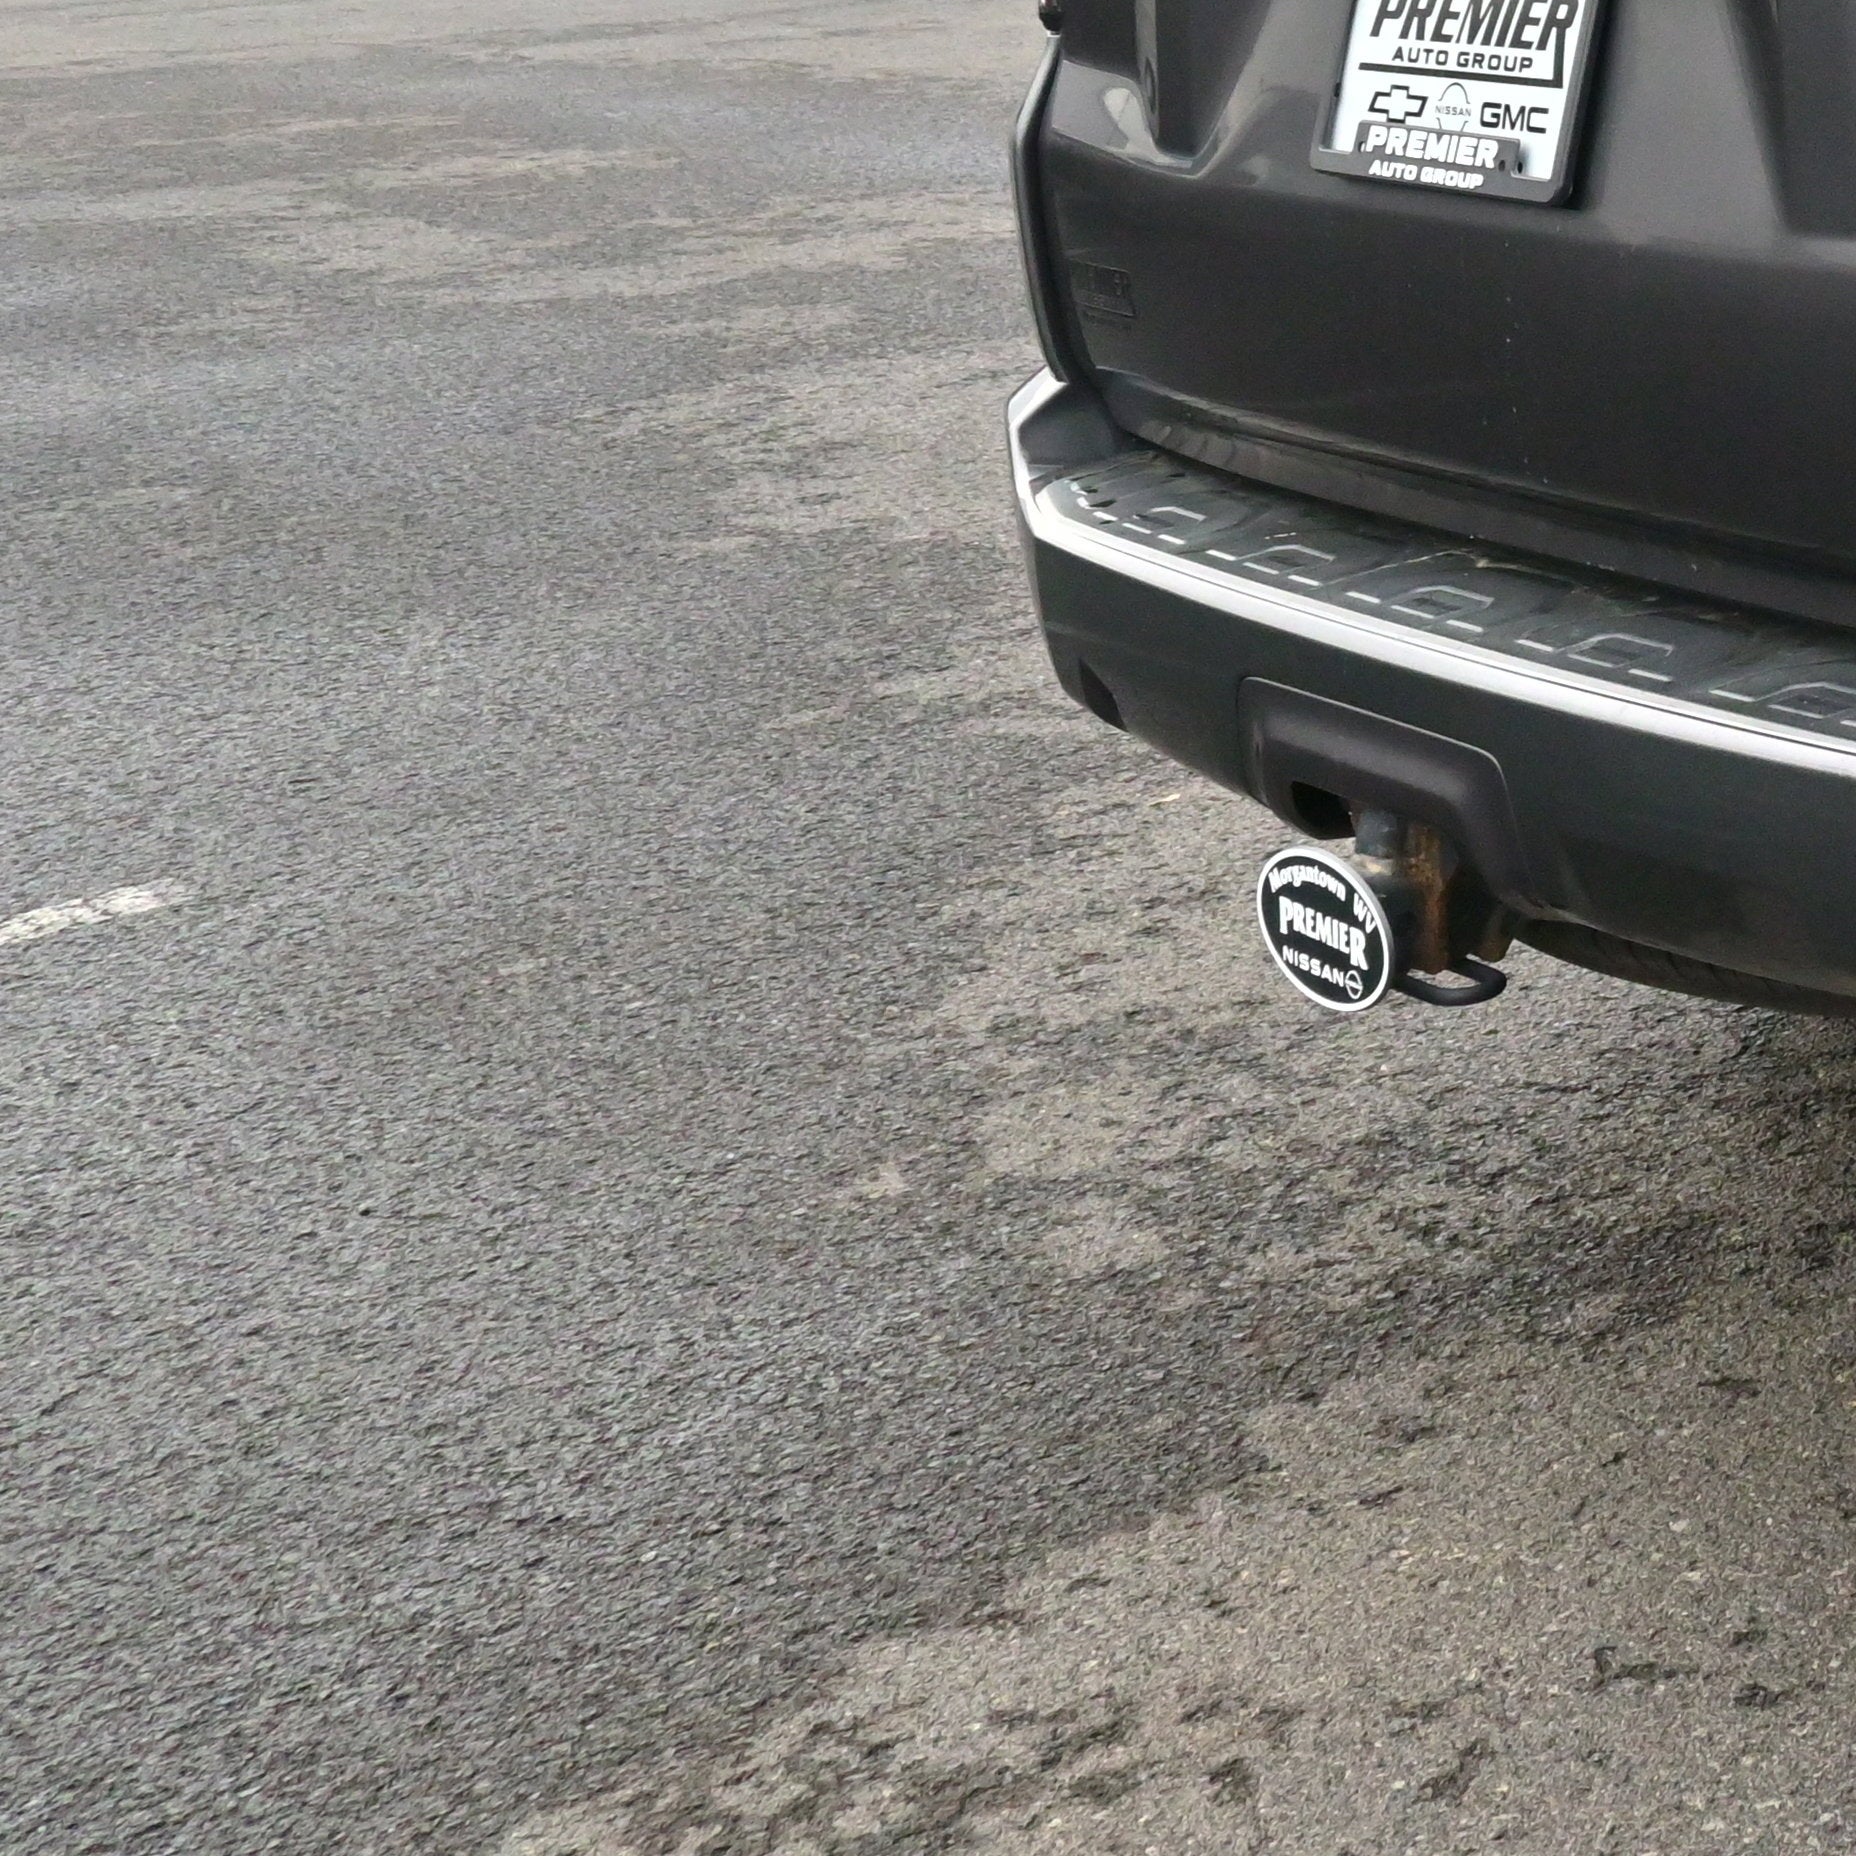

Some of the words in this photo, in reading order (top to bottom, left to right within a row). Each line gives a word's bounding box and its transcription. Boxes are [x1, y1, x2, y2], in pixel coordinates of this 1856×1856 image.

[1391, 46, 1449, 66] AUTO
[1456, 51, 1534, 73] GROUP
[1435, 104, 1472, 117] NISSAN
[1479, 101, 1550, 134] GMC
[1364, 125, 1499, 169] PREMIER
[1369, 159, 1417, 181] AUTO
[1420, 165, 1484, 190] GROUP
[1268, 864, 1346, 901] Morgantown
[1353, 892, 1377, 934] WV
[1279, 895, 1369, 970] PREMIER
[1282, 945, 1344, 988] NISSAN
